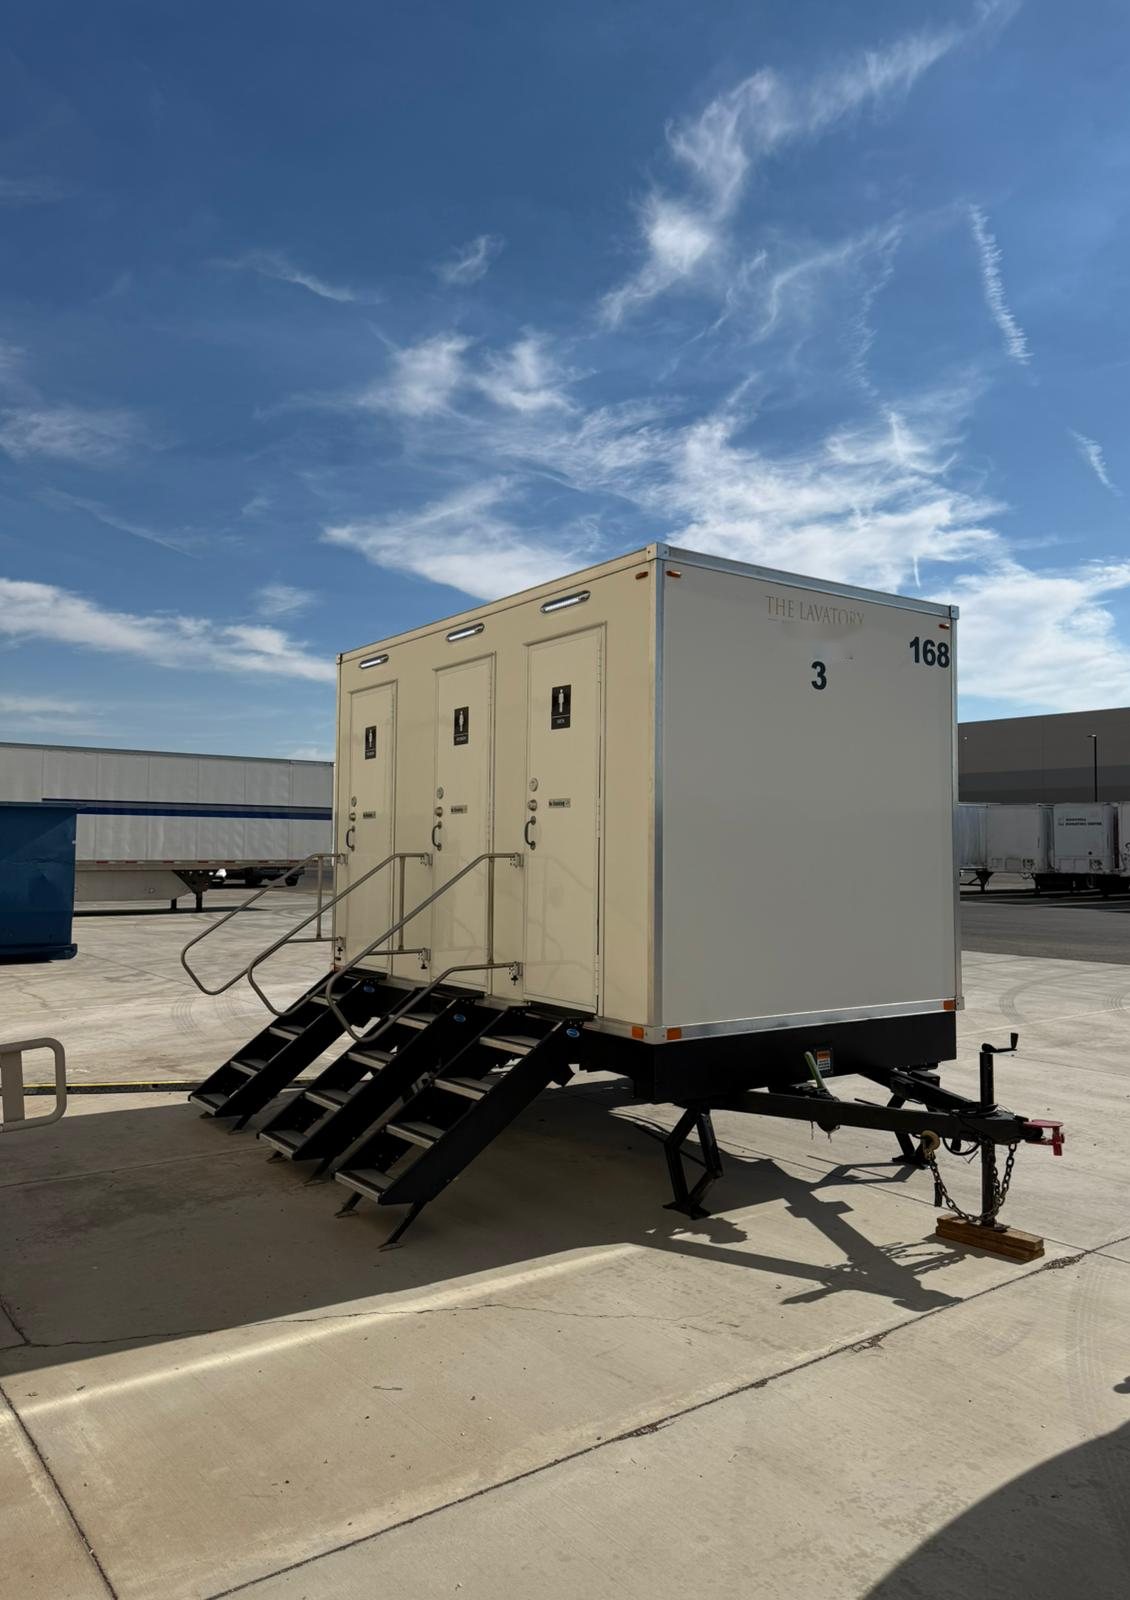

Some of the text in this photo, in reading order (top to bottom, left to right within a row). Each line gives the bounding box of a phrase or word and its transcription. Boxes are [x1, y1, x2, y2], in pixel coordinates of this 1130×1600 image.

[765, 595, 865, 625] THE LAVATORY
[909, 636, 950, 668] 168
[811, 661, 827, 690] 3
